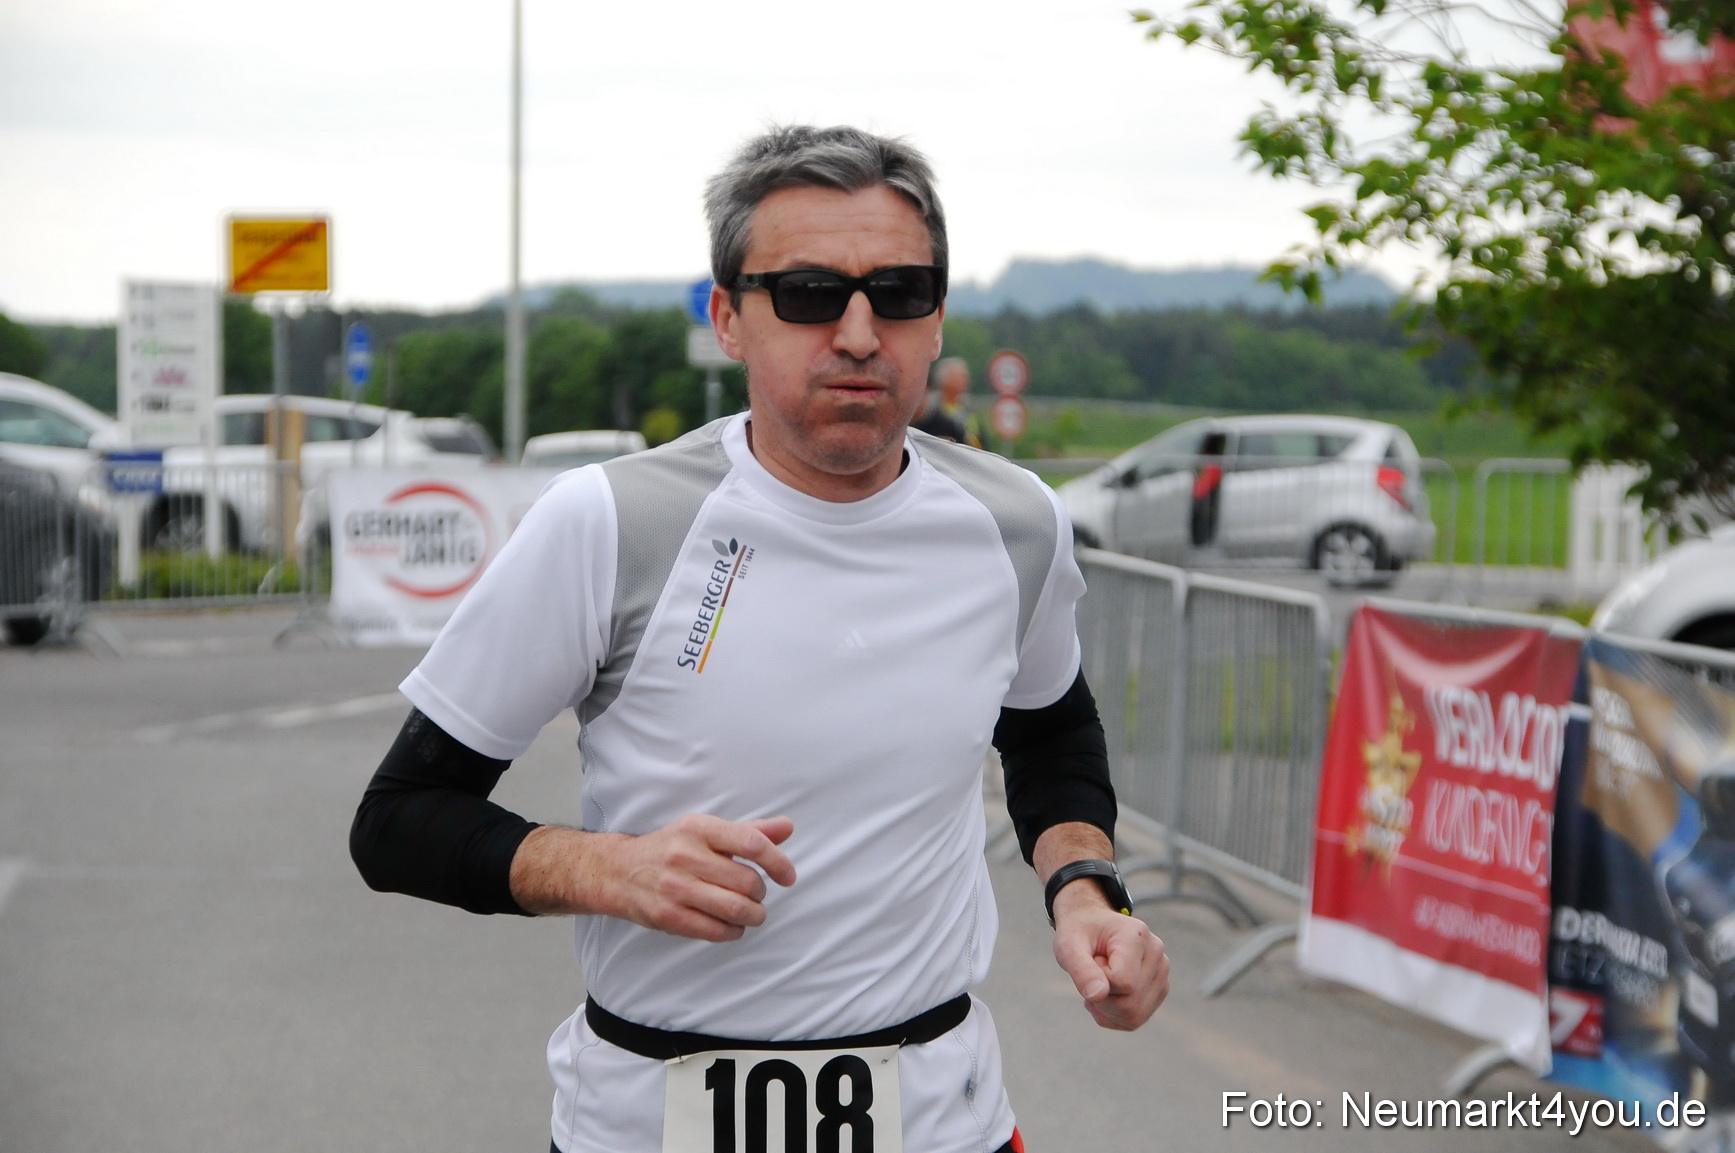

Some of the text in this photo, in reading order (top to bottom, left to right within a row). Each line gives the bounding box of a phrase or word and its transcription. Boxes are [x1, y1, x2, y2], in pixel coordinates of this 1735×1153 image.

[737, 547, 756, 580] SEIT 1844
[677, 559, 732, 671] SEEBERGER
[705, 1054, 874, 1153] 108
